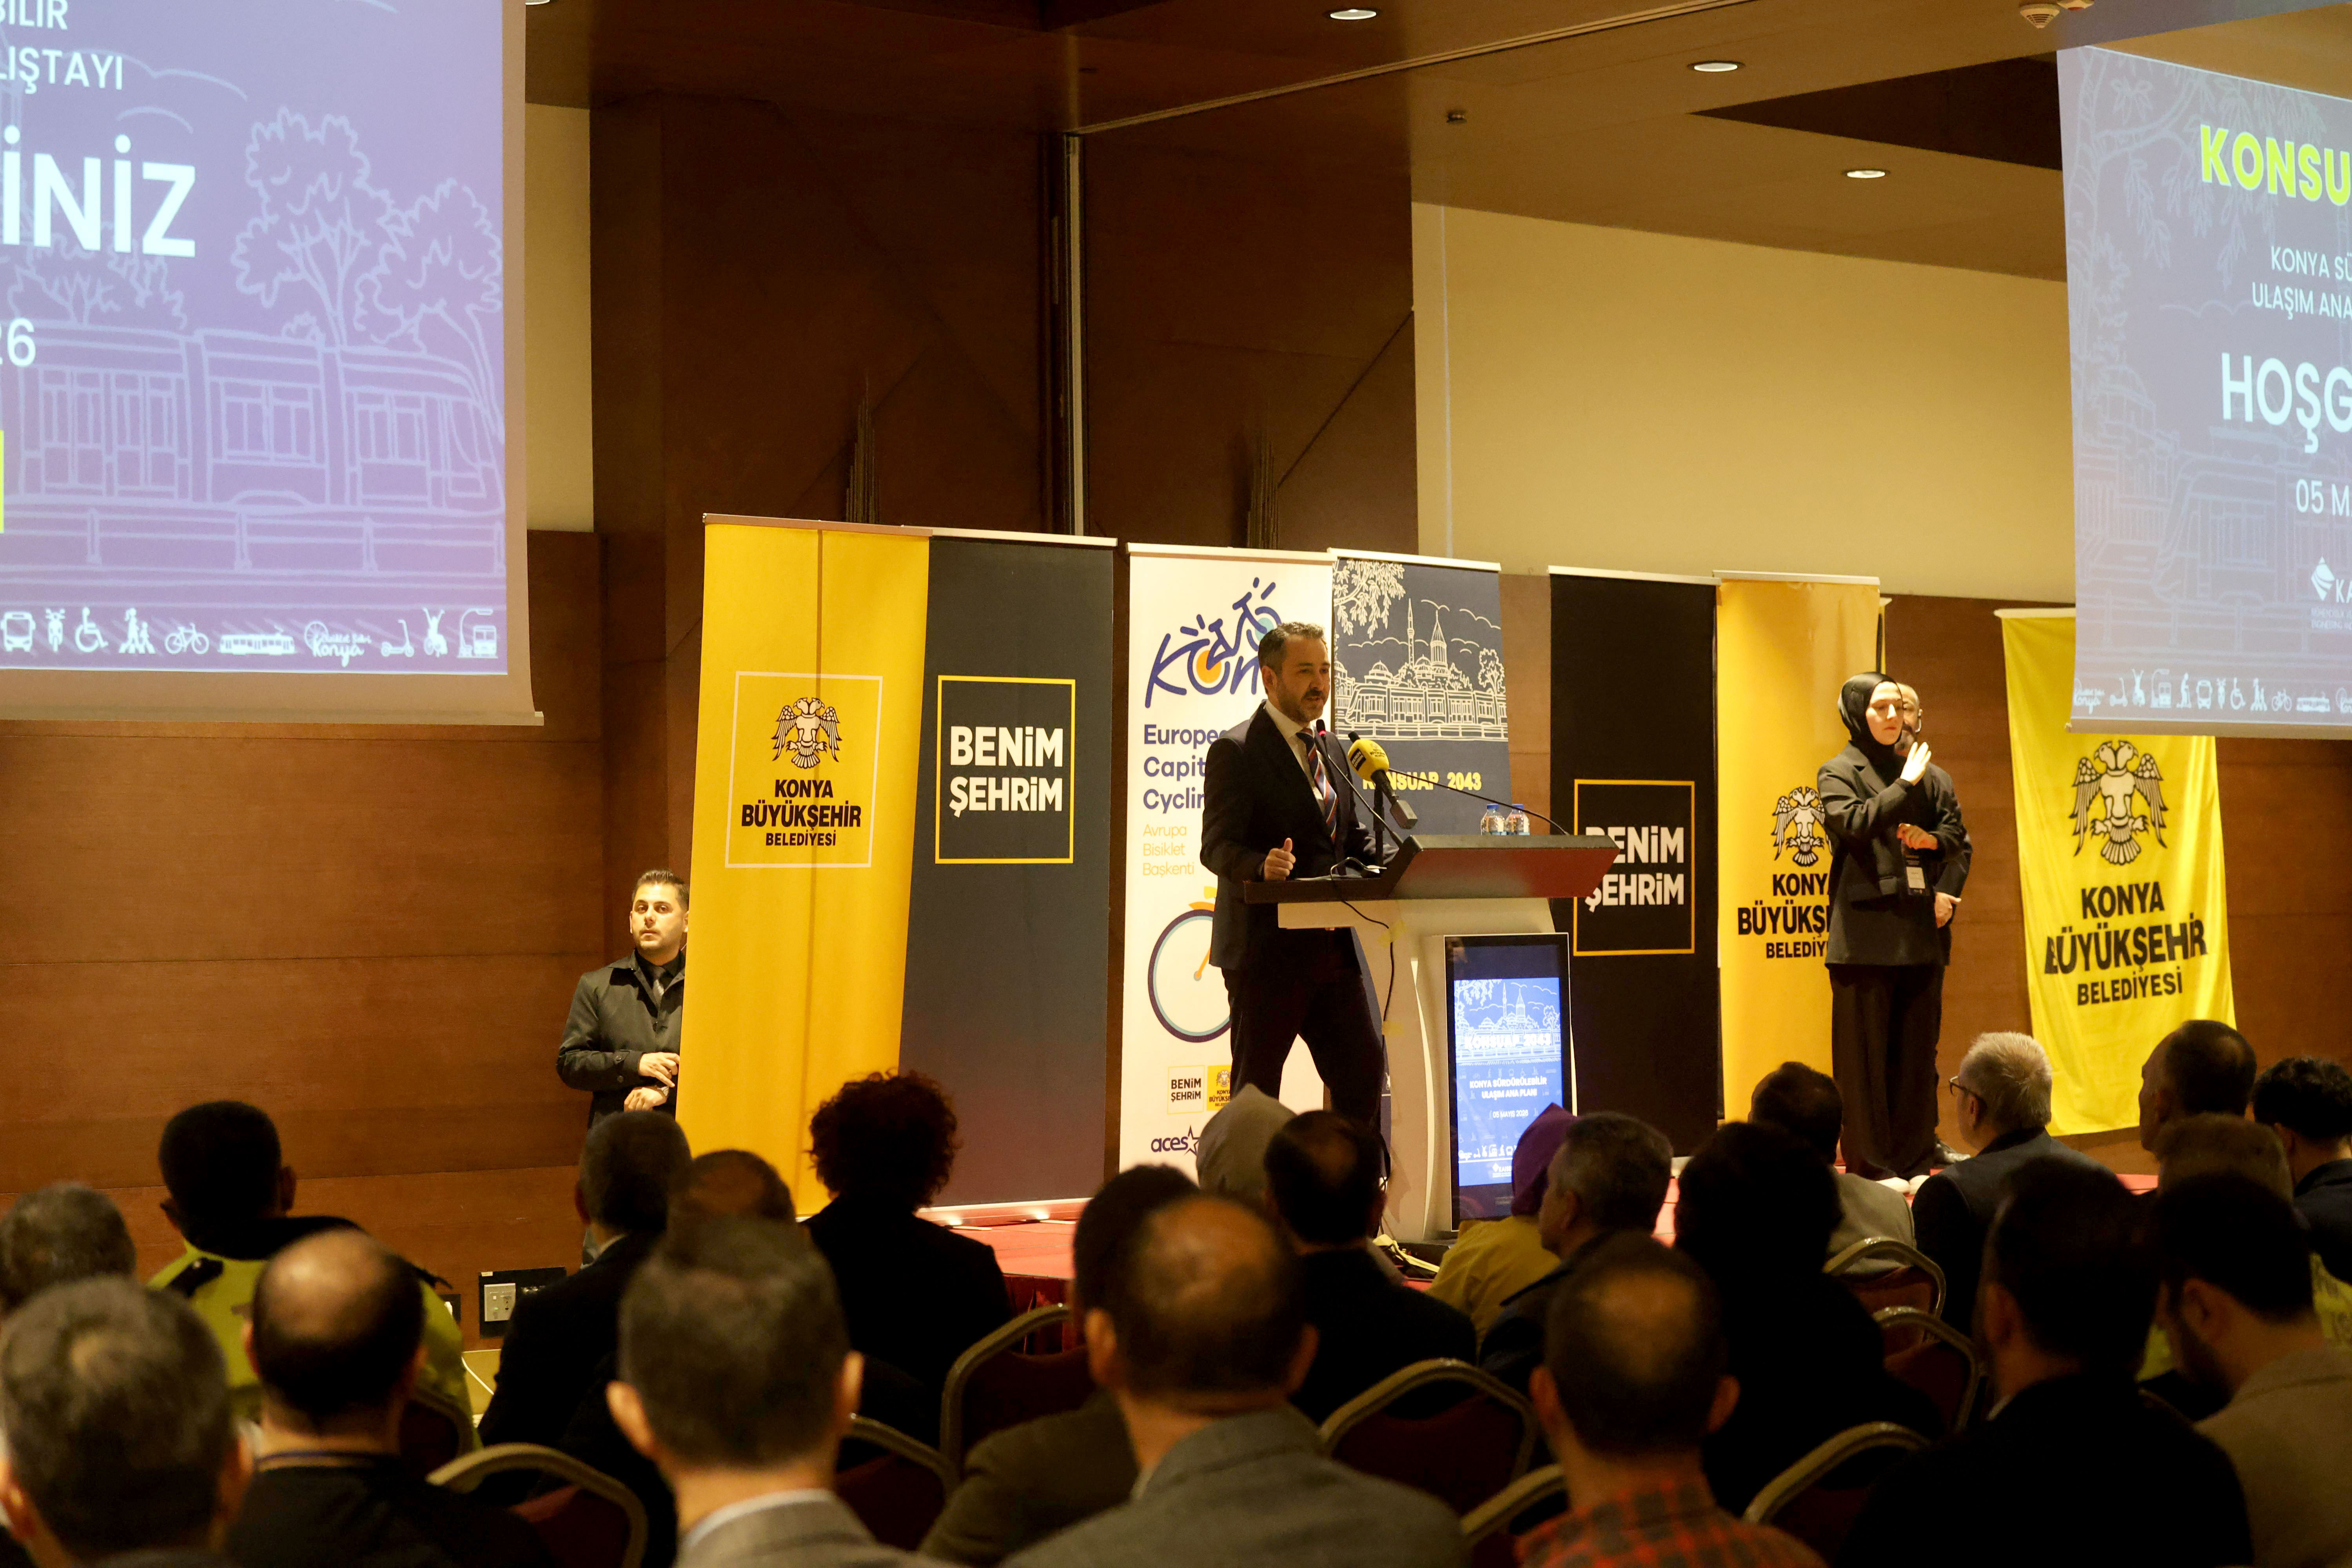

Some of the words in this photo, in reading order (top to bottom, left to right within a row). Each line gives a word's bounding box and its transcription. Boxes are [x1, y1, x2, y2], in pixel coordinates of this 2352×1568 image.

[2200, 124, 2351, 206] KONSU
[2, 124, 196, 258] İNİZ
[2271, 245, 2330, 278] KONYA
[2252, 281, 2314, 320] ULAŞIM
[2319, 292, 2352, 320] ANA
[0, 318, 36, 367] 6
[2221, 352, 2352, 454] HOŞG
[2296, 478, 2324, 514] 05
[2331, 483, 2352, 517] M
[774, 779, 833, 799] KONYA
[1447, 771, 1482, 791] 2043
[742, 800, 861, 830] BÜYÜKŞEHİR
[765, 829, 836, 846] BELEDİYESİ
[1143, 824, 1187, 839] Avrupa
[1143, 842, 1185, 856] Bisiklet
[1143, 862, 1194, 878] Başkenti
[1773, 873, 1829, 897] KONY
[2081, 881, 2165, 919] KONYA
[1766, 937, 1828, 958] BELEDİY
[2077, 965, 2183, 1006] BELEDİYESİ
[1470, 1080, 1492, 1089] KONYA
[1493, 1076, 1547, 1087] SÜRDÜRÜLEBİLİR
[1482, 1090, 1504, 1100] ULAŞIM
[1520, 1089, 1537, 1097] PLANI
[1151, 1136, 1188, 1152] aces
